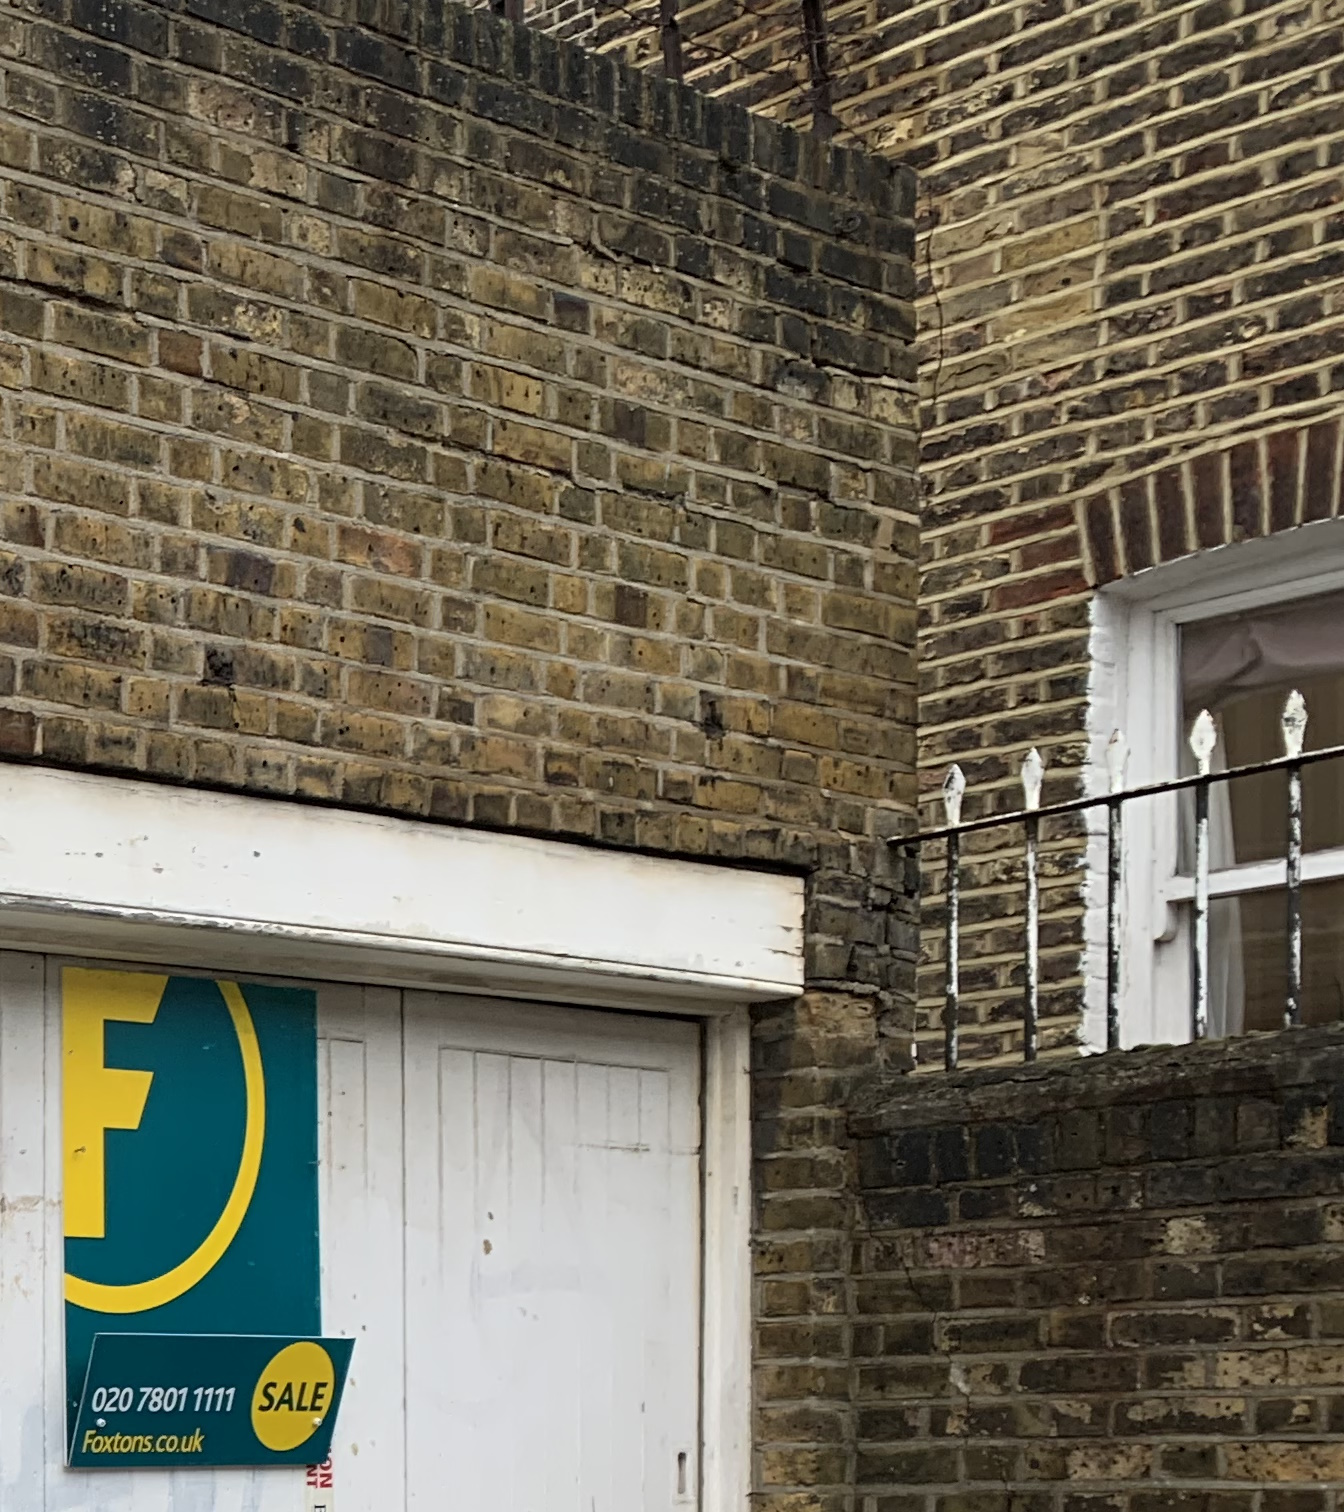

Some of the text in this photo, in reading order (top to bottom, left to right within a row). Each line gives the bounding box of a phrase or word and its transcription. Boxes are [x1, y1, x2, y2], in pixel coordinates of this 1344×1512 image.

[91, 1386, 236, 1413] 020 7801 1111
[257, 1381, 329, 1412] SALE
[81, 1427, 205, 1454] Foxtons.co.uk
